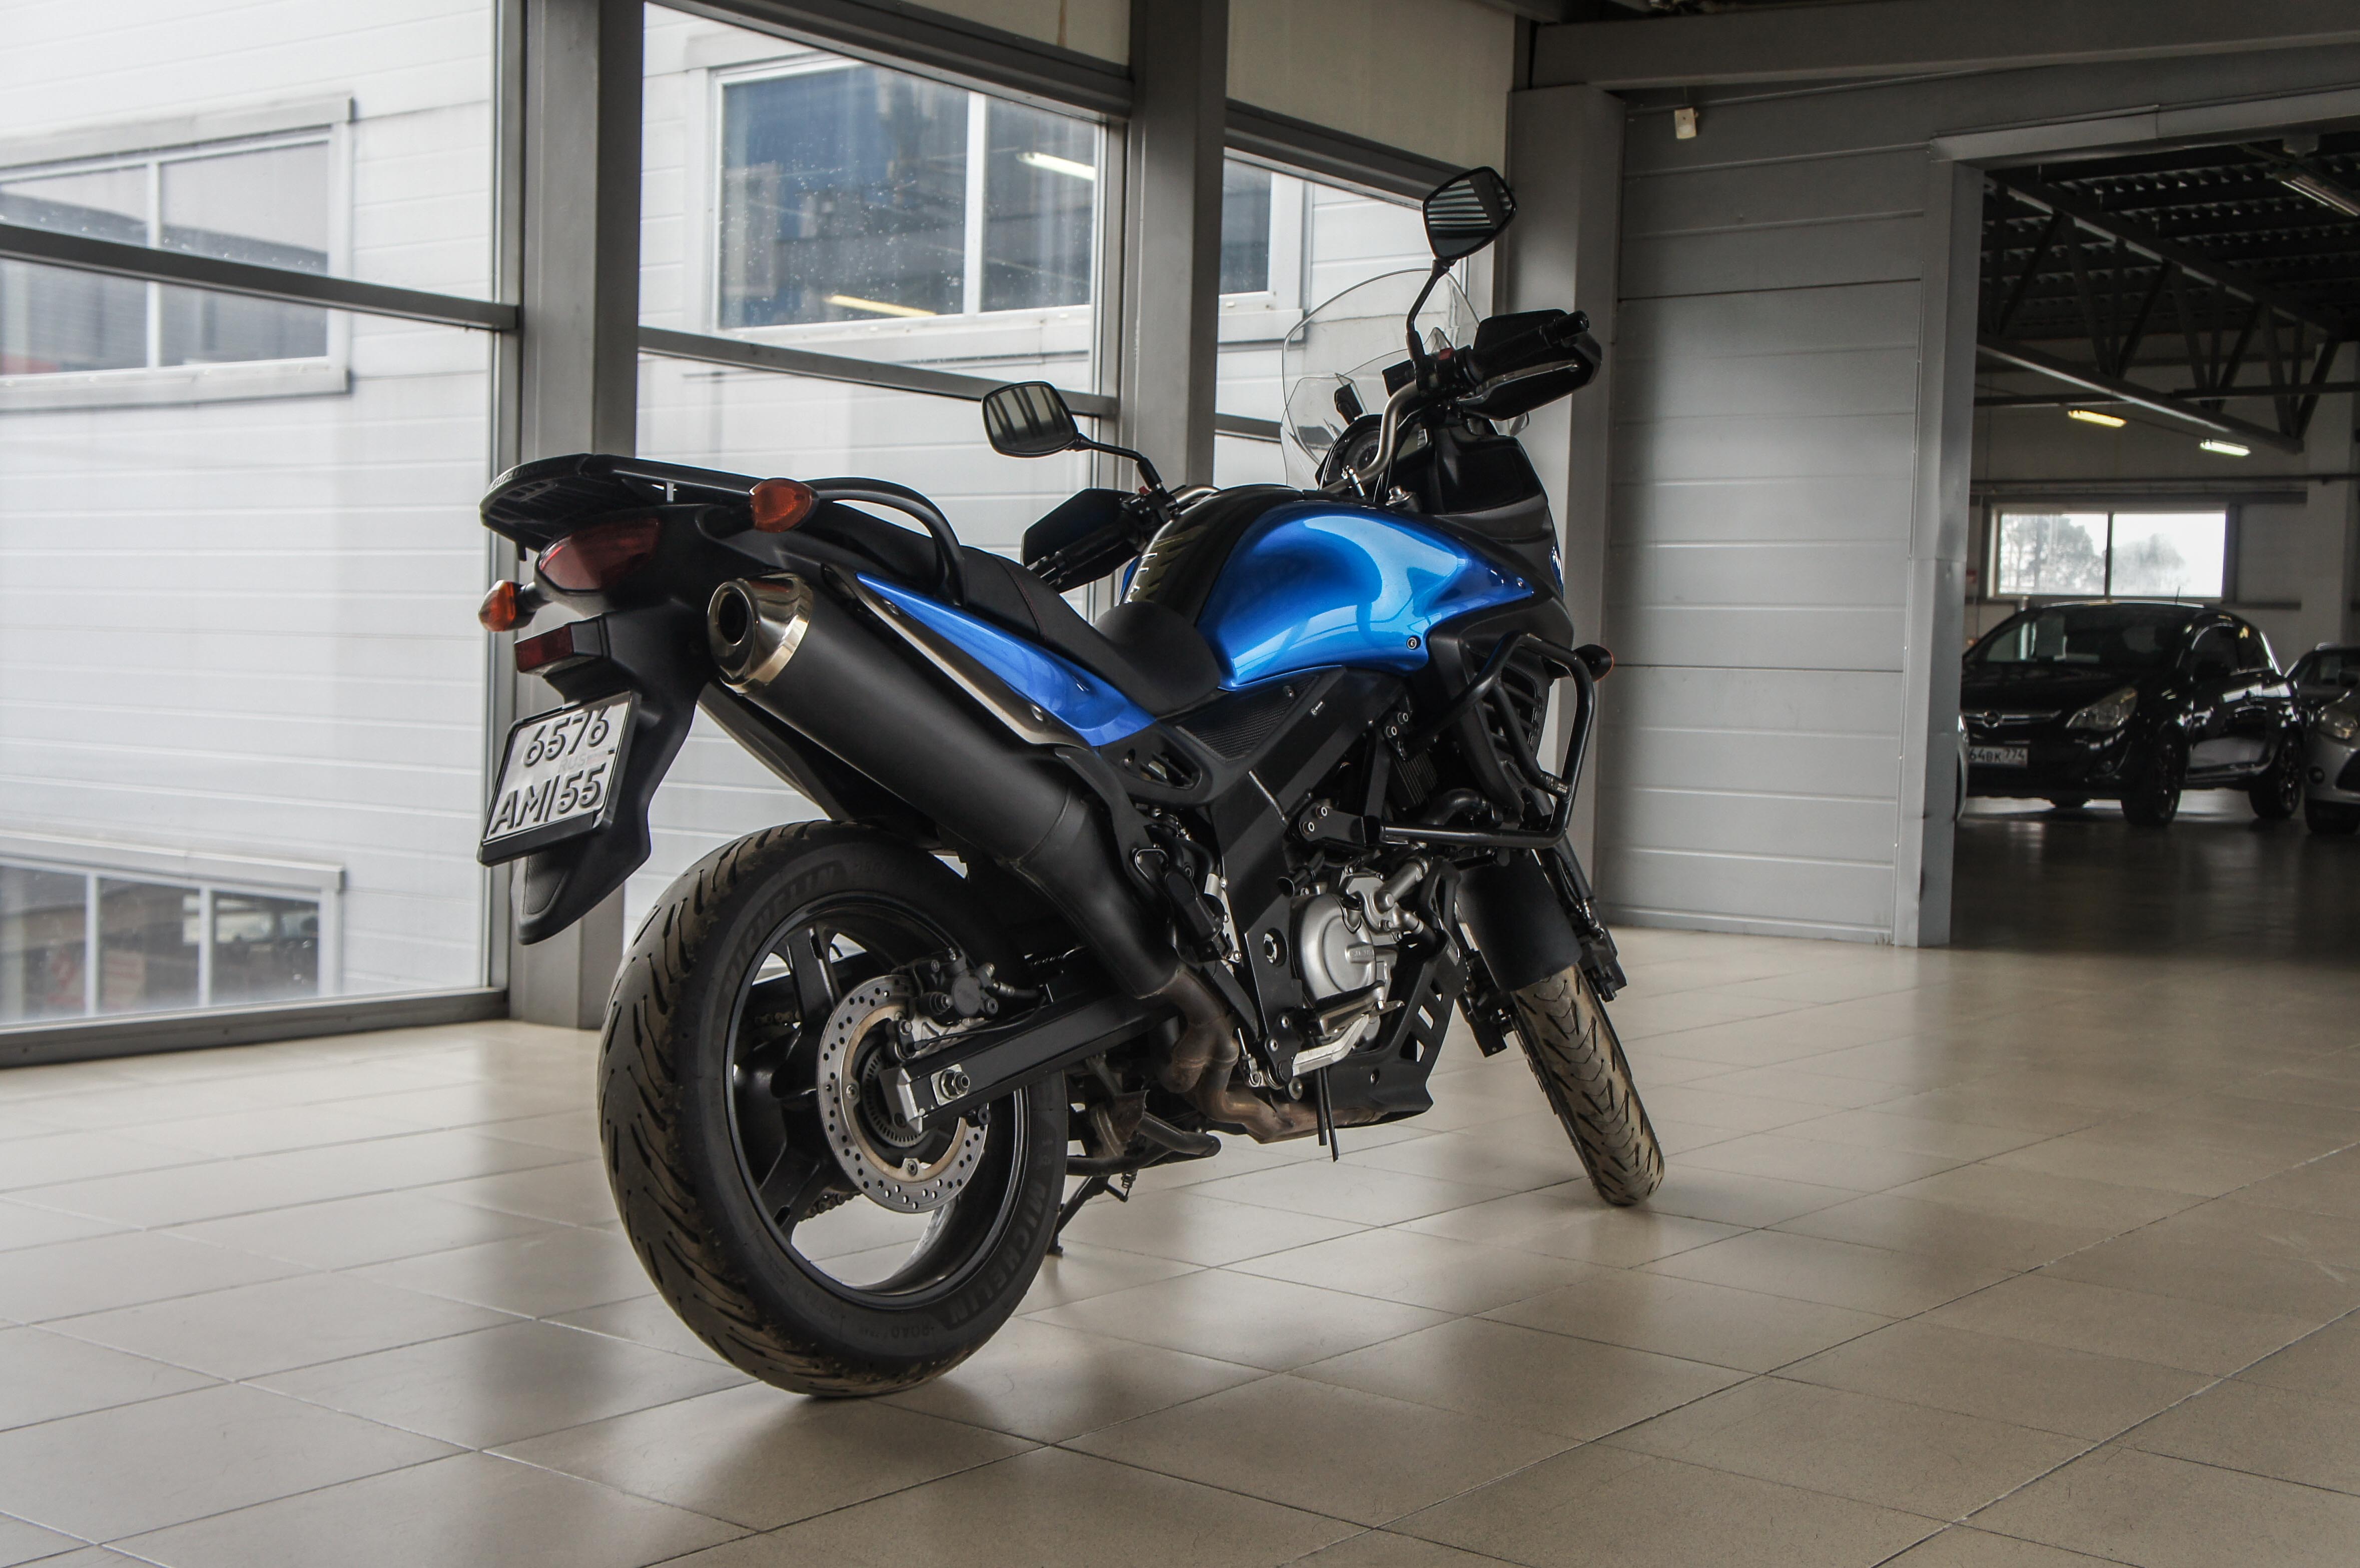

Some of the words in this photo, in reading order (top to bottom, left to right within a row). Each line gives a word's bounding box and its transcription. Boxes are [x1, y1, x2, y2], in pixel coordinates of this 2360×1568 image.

[522, 704, 610, 767] 6576
[558, 752, 586, 772] RUS
[490, 778, 551, 836] AM
[556, 762, 606, 815] 55
[948, 1181, 1046, 1324] MICHELIN
